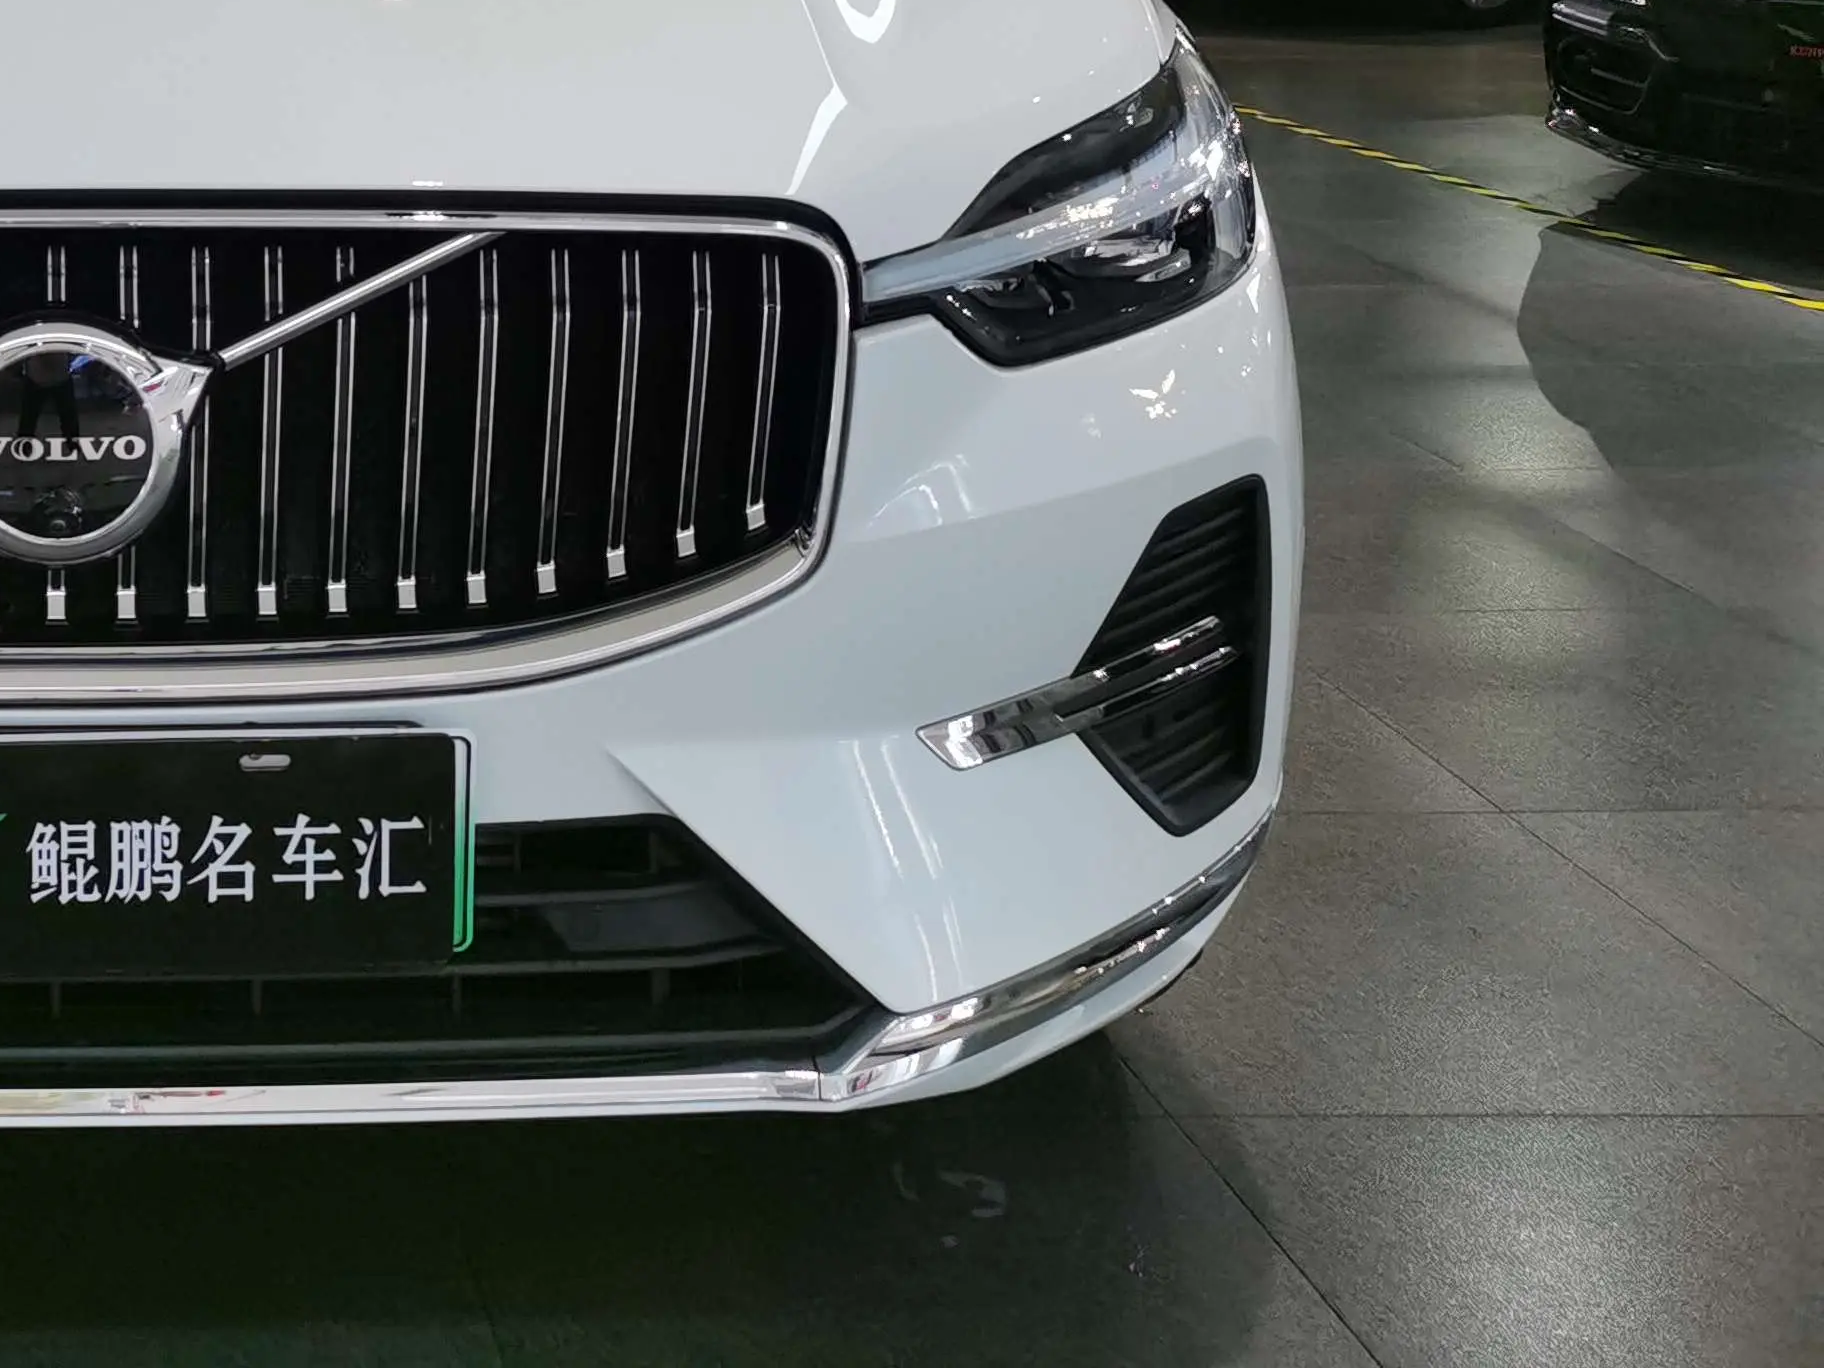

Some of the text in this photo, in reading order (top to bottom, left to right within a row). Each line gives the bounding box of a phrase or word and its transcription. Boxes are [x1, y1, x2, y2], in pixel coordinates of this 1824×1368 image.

[26, 815, 426, 905] 鲲鹏名车汇
